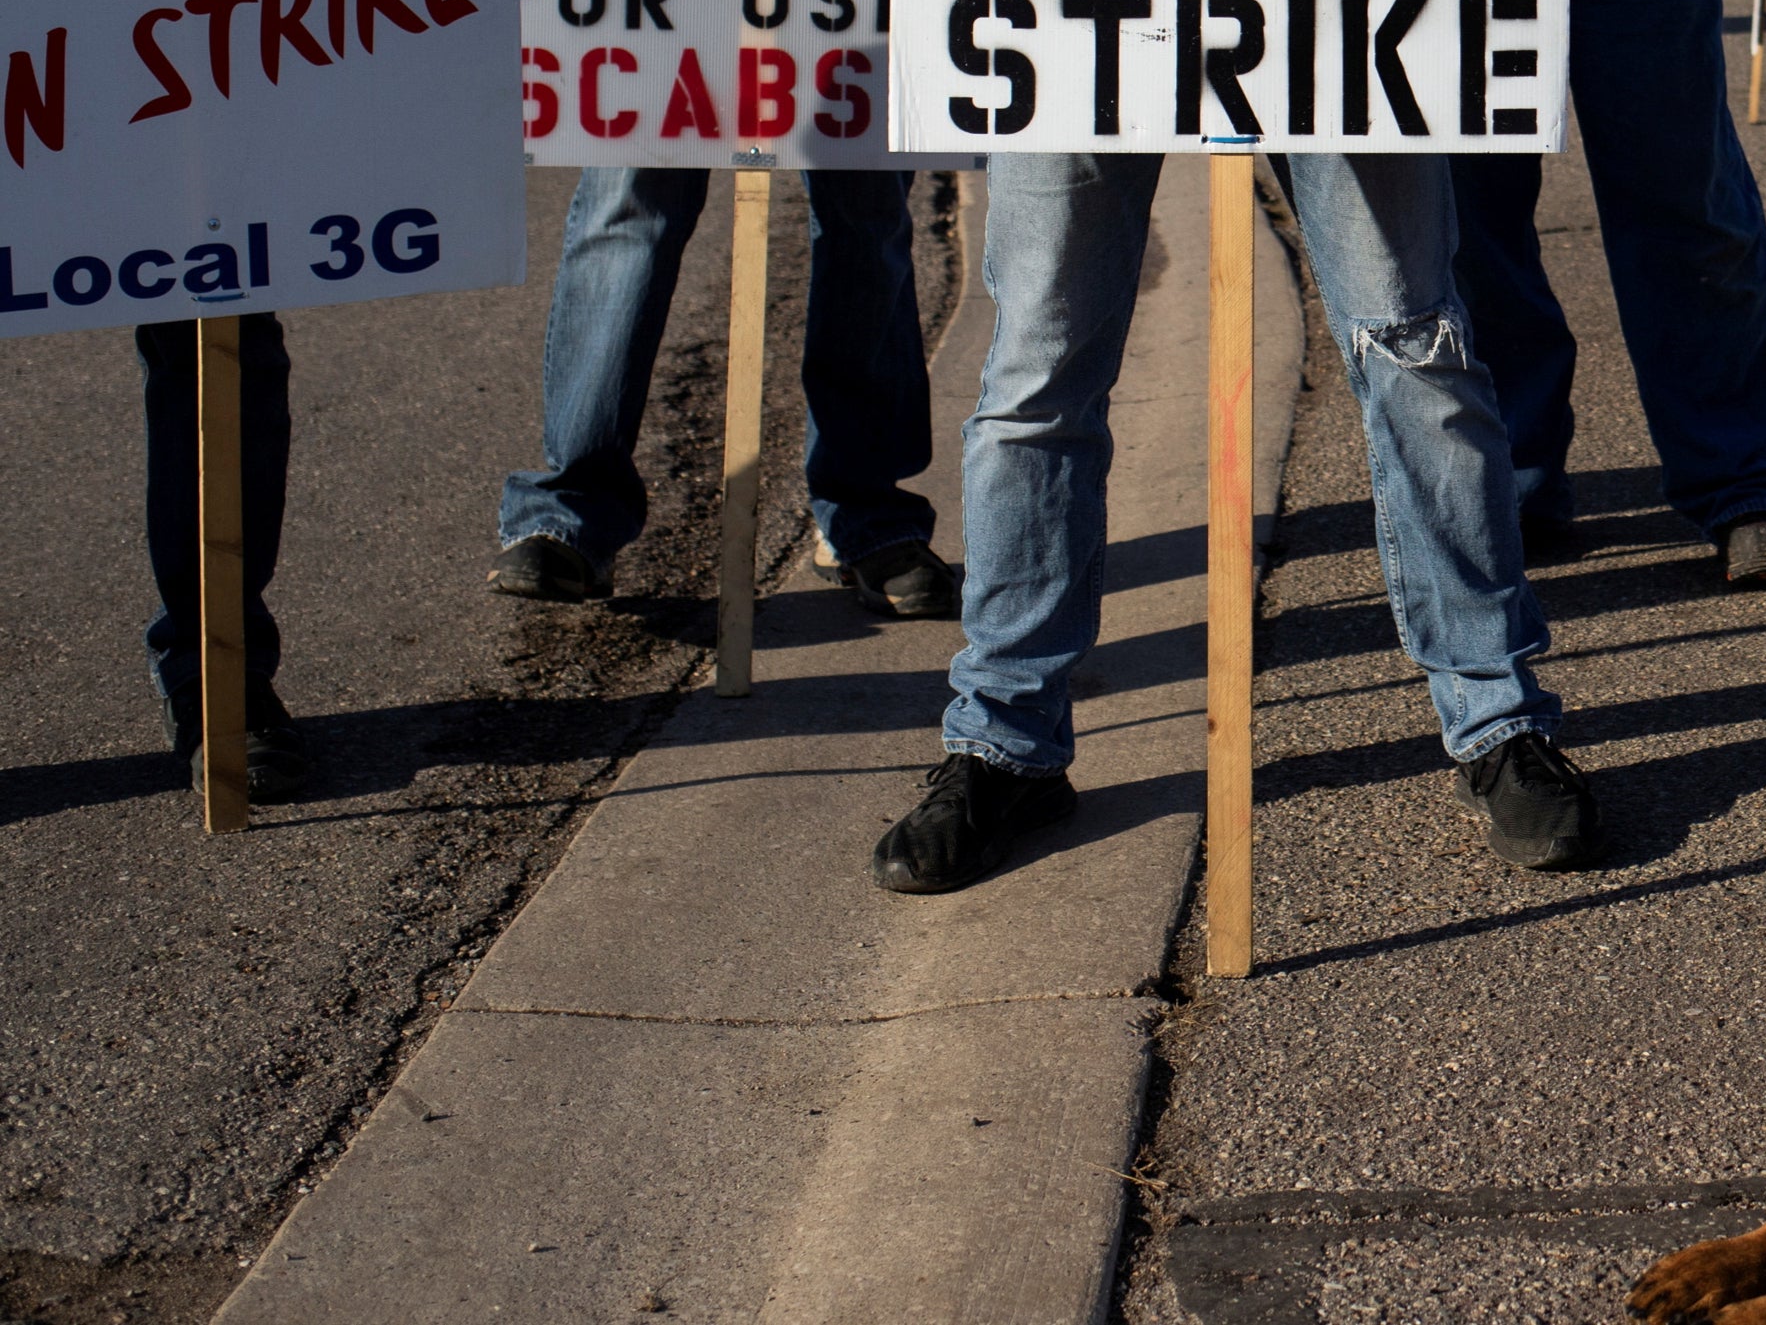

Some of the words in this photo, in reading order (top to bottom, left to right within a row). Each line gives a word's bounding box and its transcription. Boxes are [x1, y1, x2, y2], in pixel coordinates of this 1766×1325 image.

[4, 27, 68, 170] N
[523, 47, 872, 139] SCABS
[0, 222, 271, 313] Local
[309, 208, 441, 281] 3G
